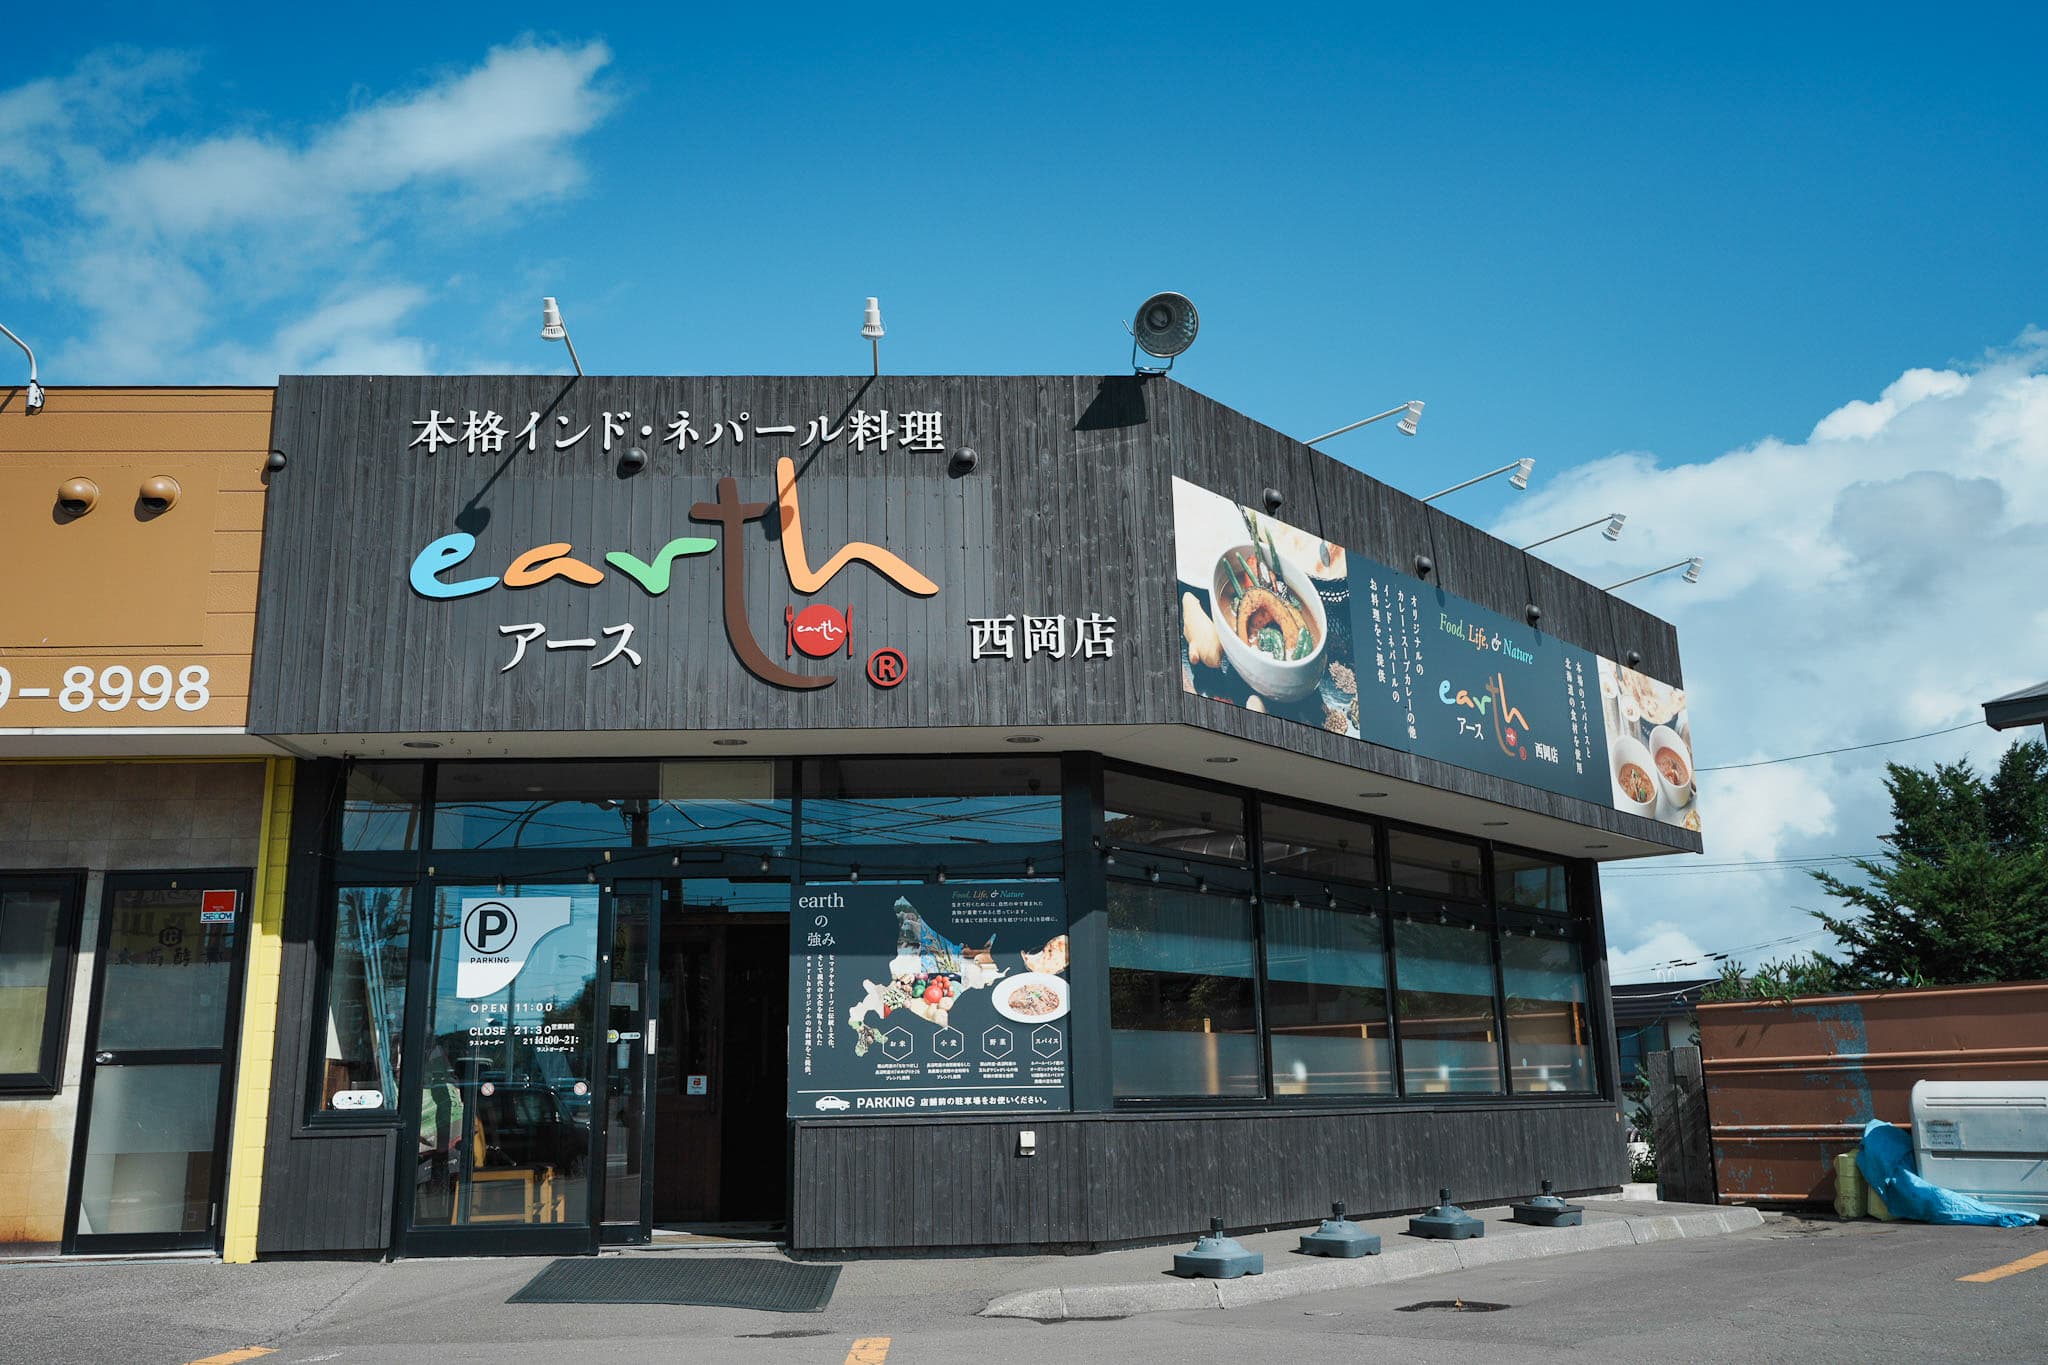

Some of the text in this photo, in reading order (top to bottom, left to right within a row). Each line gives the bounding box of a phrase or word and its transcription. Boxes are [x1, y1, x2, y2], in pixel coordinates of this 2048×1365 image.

[410, 410, 945, 453] 本格インド・ネパール料理
[409, 457, 939, 688] earth
[797, 619, 843, 641] earth
[968, 612, 1117, 660] 西岡店
[1411, 595, 1424, 676] オリジナルの
[499, 622, 642, 670] アース
[1384, 584, 1400, 703] インド・ネパールの
[1491, 633, 1502, 651] &
[1503, 638, 1534, 665] Nature
[1397, 590, 1417, 740] カレー・スープカレーの他
[1439, 672, 1529, 756] earth
[1456, 717, 1484, 740] アース
[798, 892, 845, 908] earth
[1000, 890, 1025, 898] Nature
[203, 912, 232, 921] SECOM
[814, 915, 828, 928] の
[477, 909, 508, 948] P
[807, 932, 836, 947] 強み
[470, 956, 510, 964] PARKING
[470, 1002, 553, 1013] OPEN 11:00
[469, 1025, 551, 1036] CLOSE 21:30
[857, 1095, 1047, 1109] PARKING 店舗前の駐車場をお使いください。
